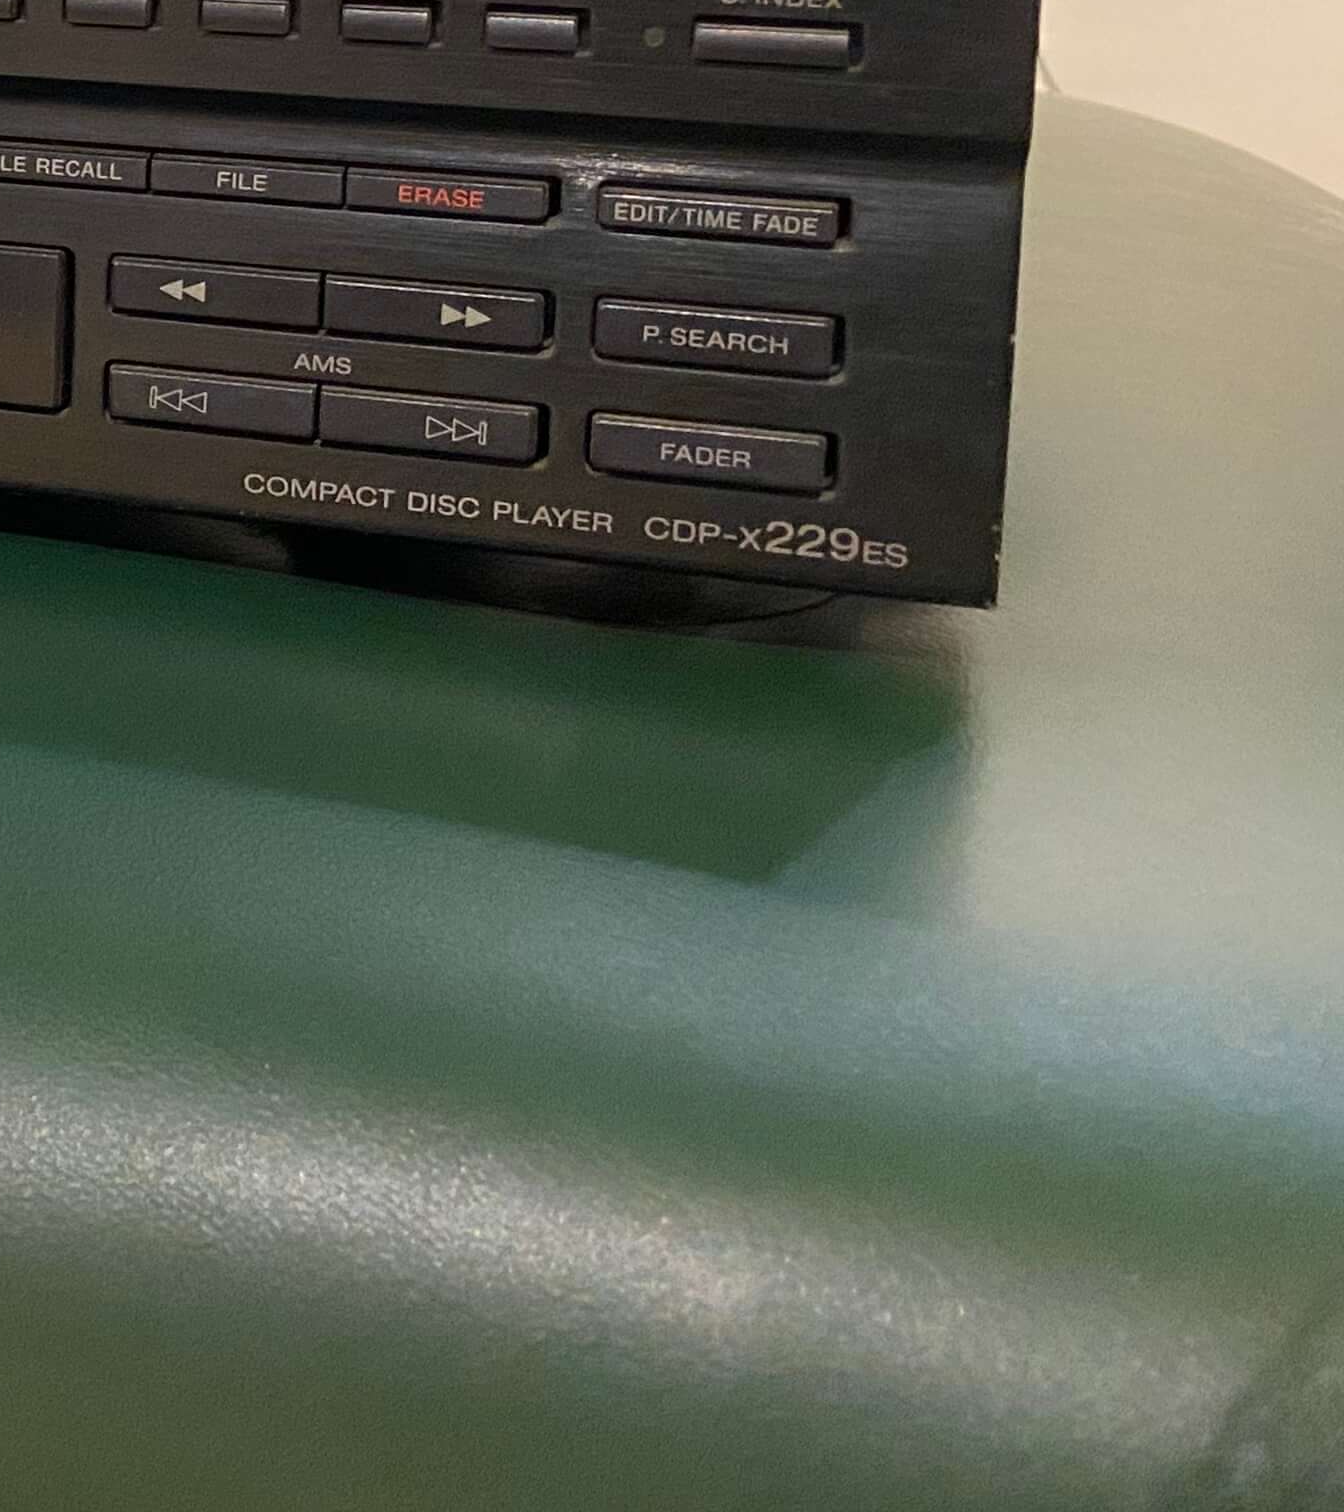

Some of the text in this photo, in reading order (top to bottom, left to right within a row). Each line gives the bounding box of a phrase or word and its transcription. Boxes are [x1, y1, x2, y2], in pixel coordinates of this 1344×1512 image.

[36, 158, 122, 181] RECALL
[217, 170, 268, 192] FILE
[397, 183, 485, 209] ERASE
[614, 203, 818, 236] EDIT/TIME FADE
[643, 325, 789, 355] P. SEARCH
[293, 353, 351, 375] AMS
[660, 443, 752, 468] FADER
[244, 473, 395, 510] COMPACT
[407, 491, 480, 519] DISC
[493, 501, 612, 533] PLAYER
